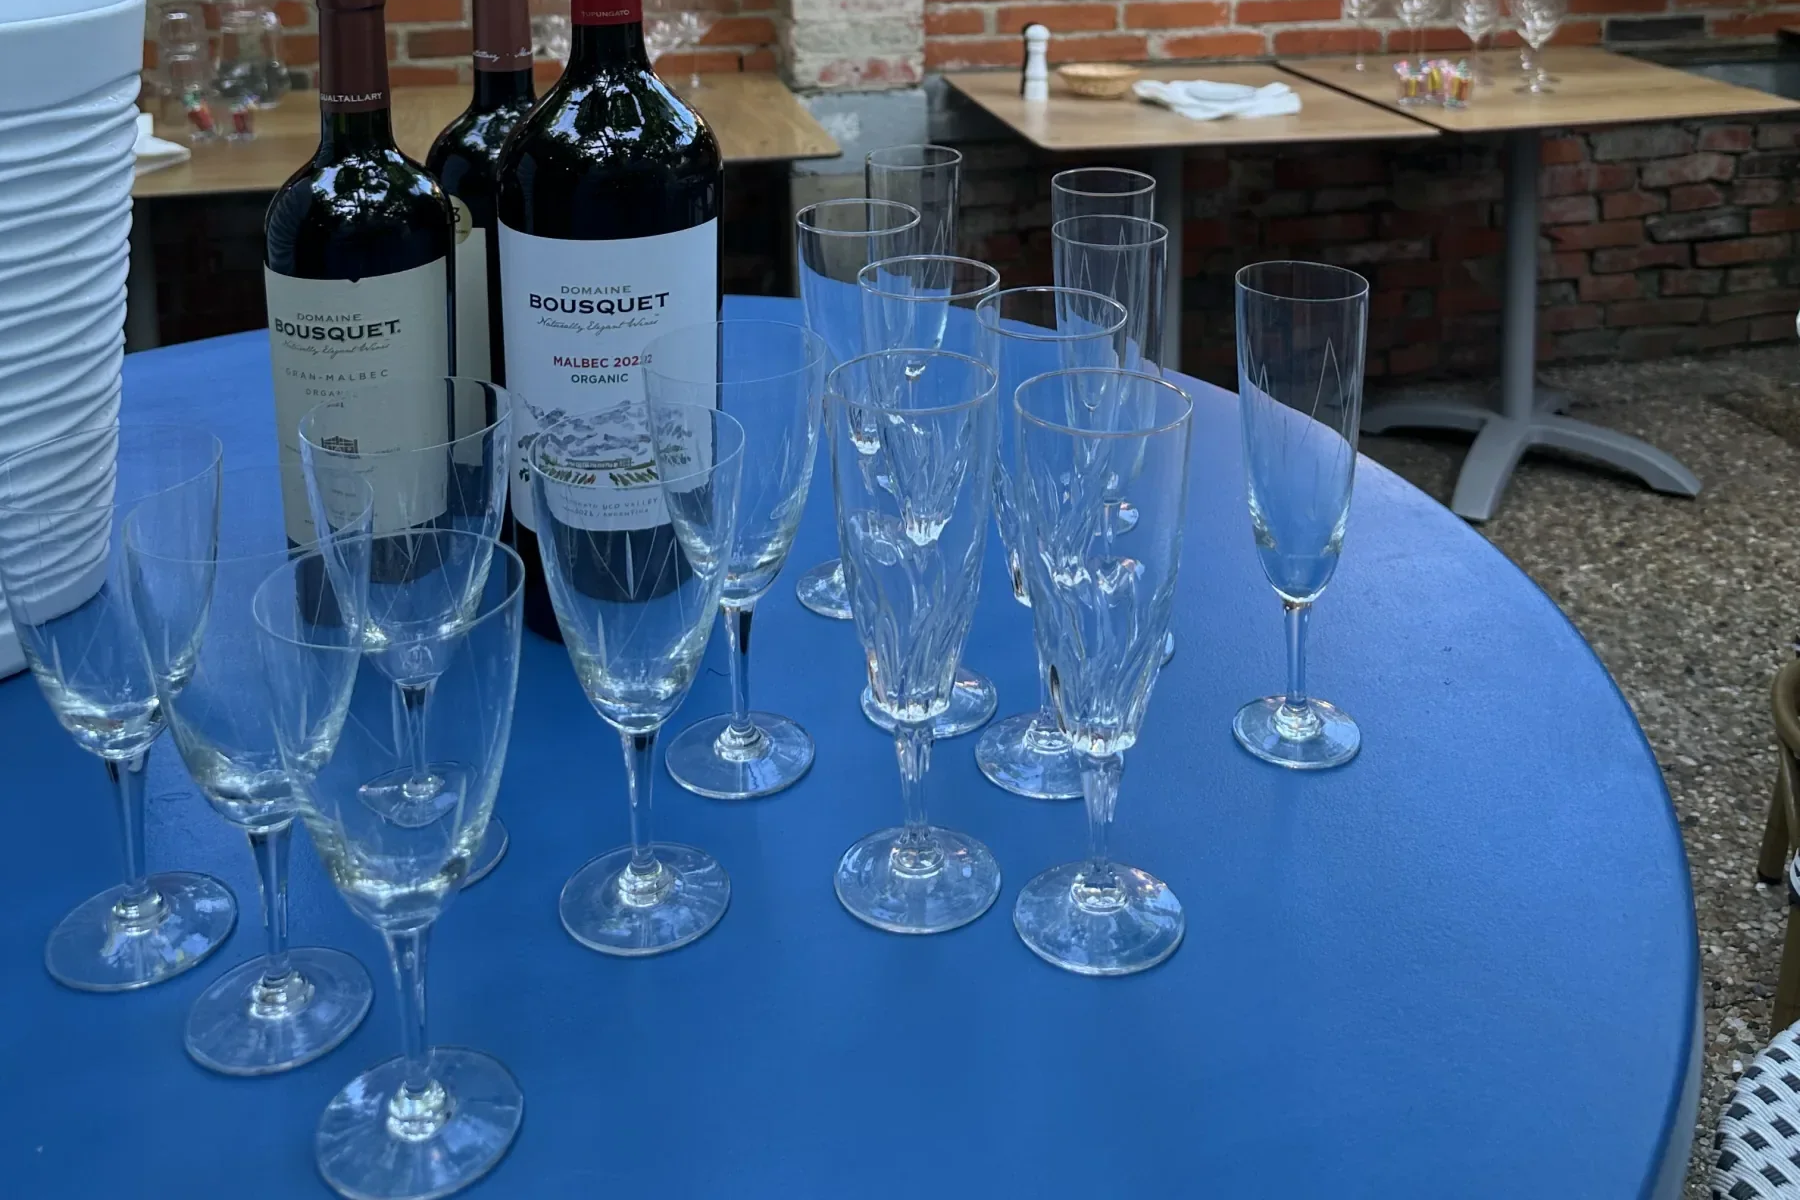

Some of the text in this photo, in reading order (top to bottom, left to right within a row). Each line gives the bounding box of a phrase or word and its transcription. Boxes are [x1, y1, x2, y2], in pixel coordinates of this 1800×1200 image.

[581, 8, 630, 18] TUPUNGATO
[561, 284, 632, 295] DOMAINE
[529, 292, 670, 315] BOUSQUET
[296, 312, 362, 323] DOMAINE
[537, 315, 585, 333] Naturally
[586, 321, 625, 336] Elegant
[553, 355, 609, 369] MALBEC
[285, 367, 389, 382] GRAN-MALBEC
[571, 373, 629, 384] ORGANIC
